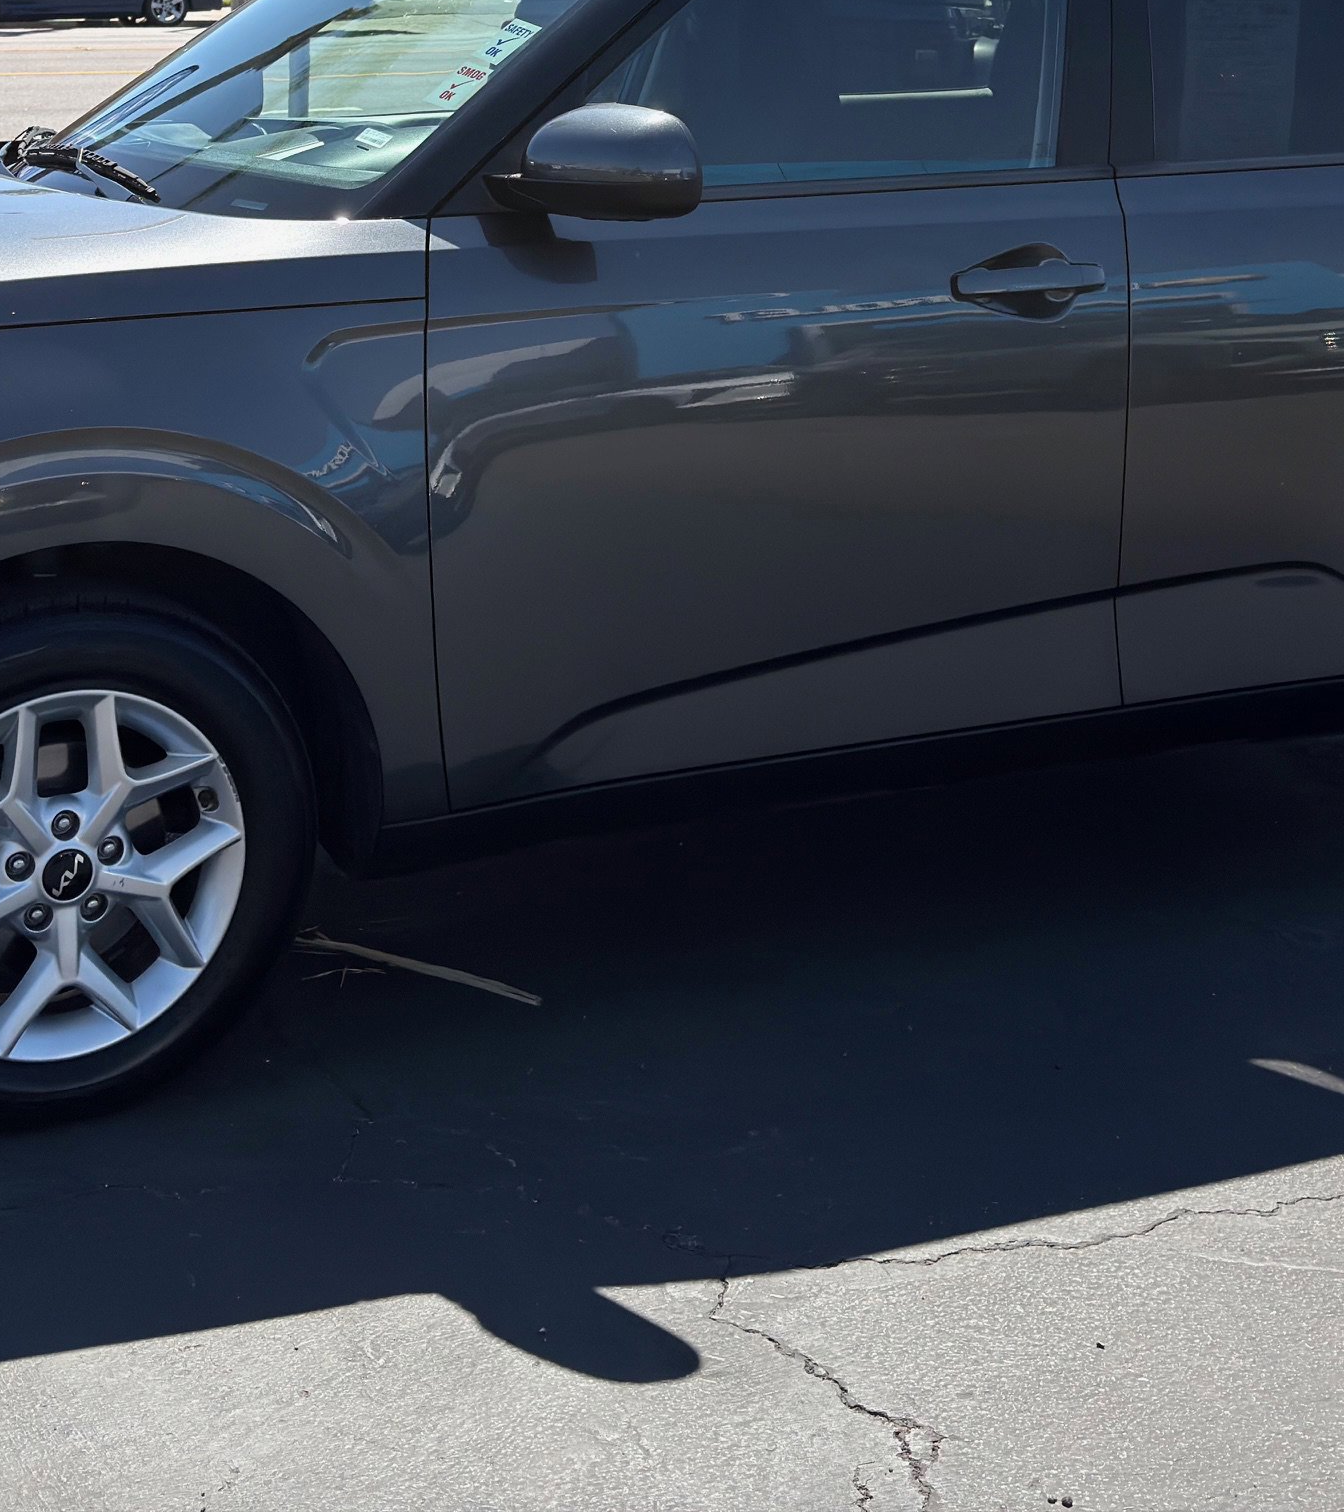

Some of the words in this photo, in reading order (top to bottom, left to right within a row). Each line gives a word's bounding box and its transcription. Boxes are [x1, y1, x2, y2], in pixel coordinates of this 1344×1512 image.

[504, 23, 535, 39] SAFETY
[485, 46, 503, 58] OK
[457, 66, 487, 81] SMOG
[438, 90, 456, 101] OK
